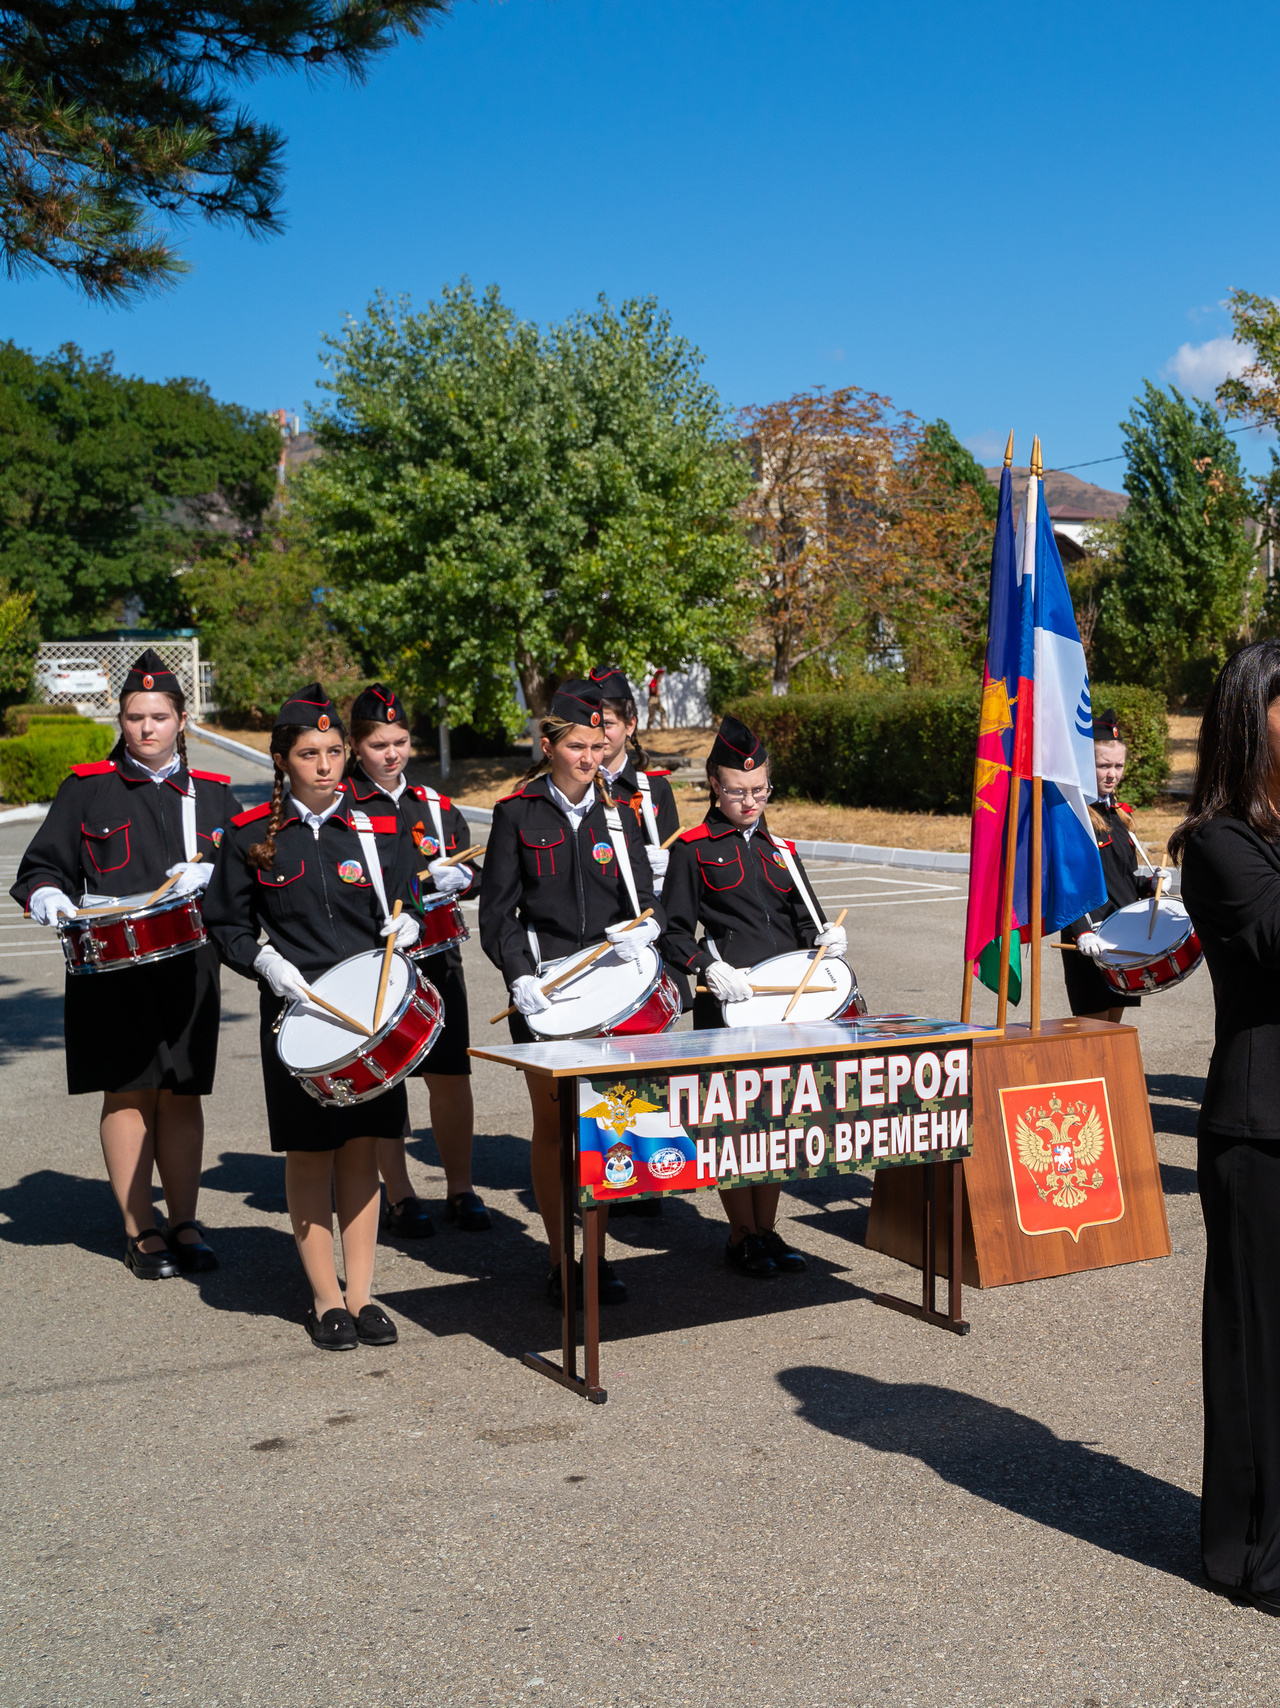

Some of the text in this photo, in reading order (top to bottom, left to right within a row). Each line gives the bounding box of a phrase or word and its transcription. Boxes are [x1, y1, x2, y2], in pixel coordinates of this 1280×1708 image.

[669, 1048, 968, 1127] ПАРТА ГЕРОЯ
[696, 1125, 826, 1180] НАШЕГО
[834, 1108, 968, 1163] ВРЕМЕНИ
